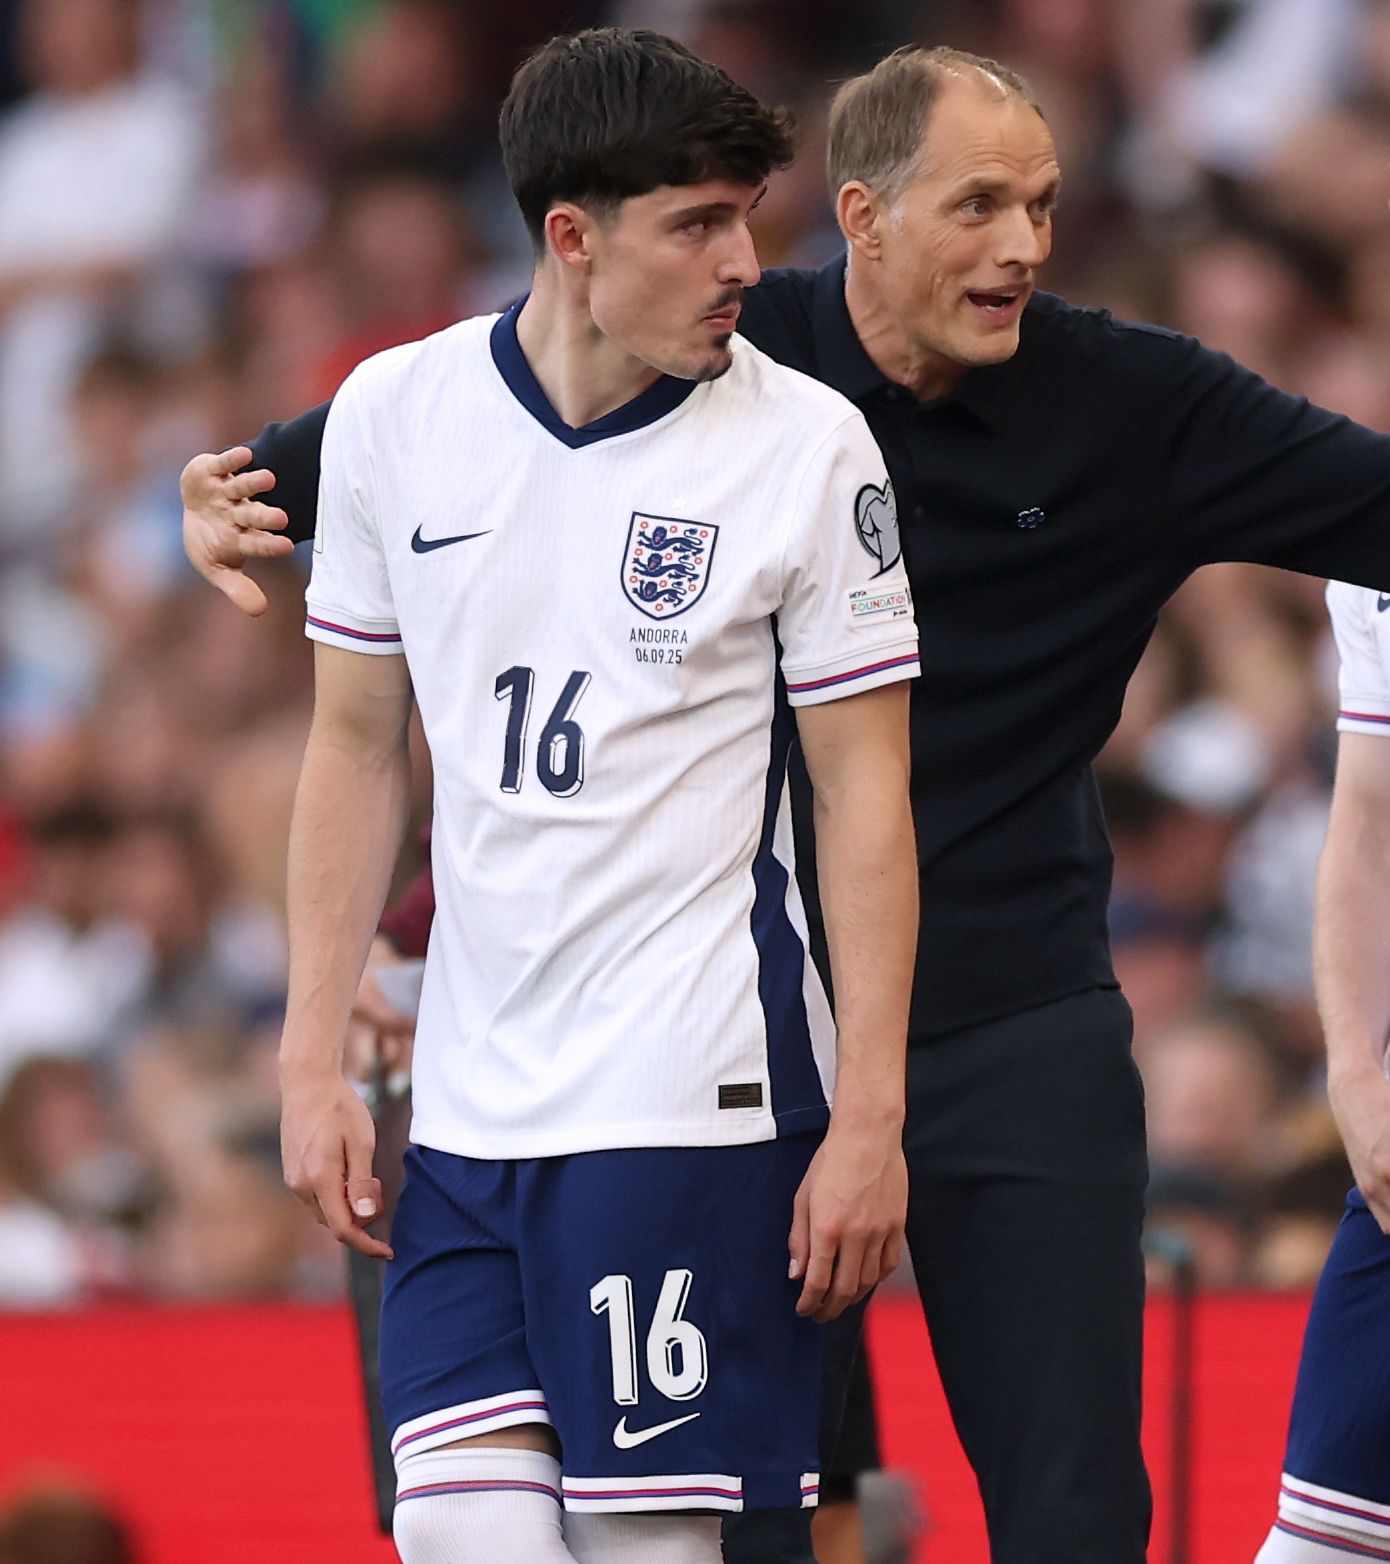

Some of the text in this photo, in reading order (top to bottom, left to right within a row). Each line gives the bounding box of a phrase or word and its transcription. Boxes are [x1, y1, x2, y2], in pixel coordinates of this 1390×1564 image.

[630, 628, 688, 644] ANDORRA
[635, 647, 682, 664] 06.09.25
[494, 665, 592, 798] 16
[589, 1268, 708, 1406] 16
